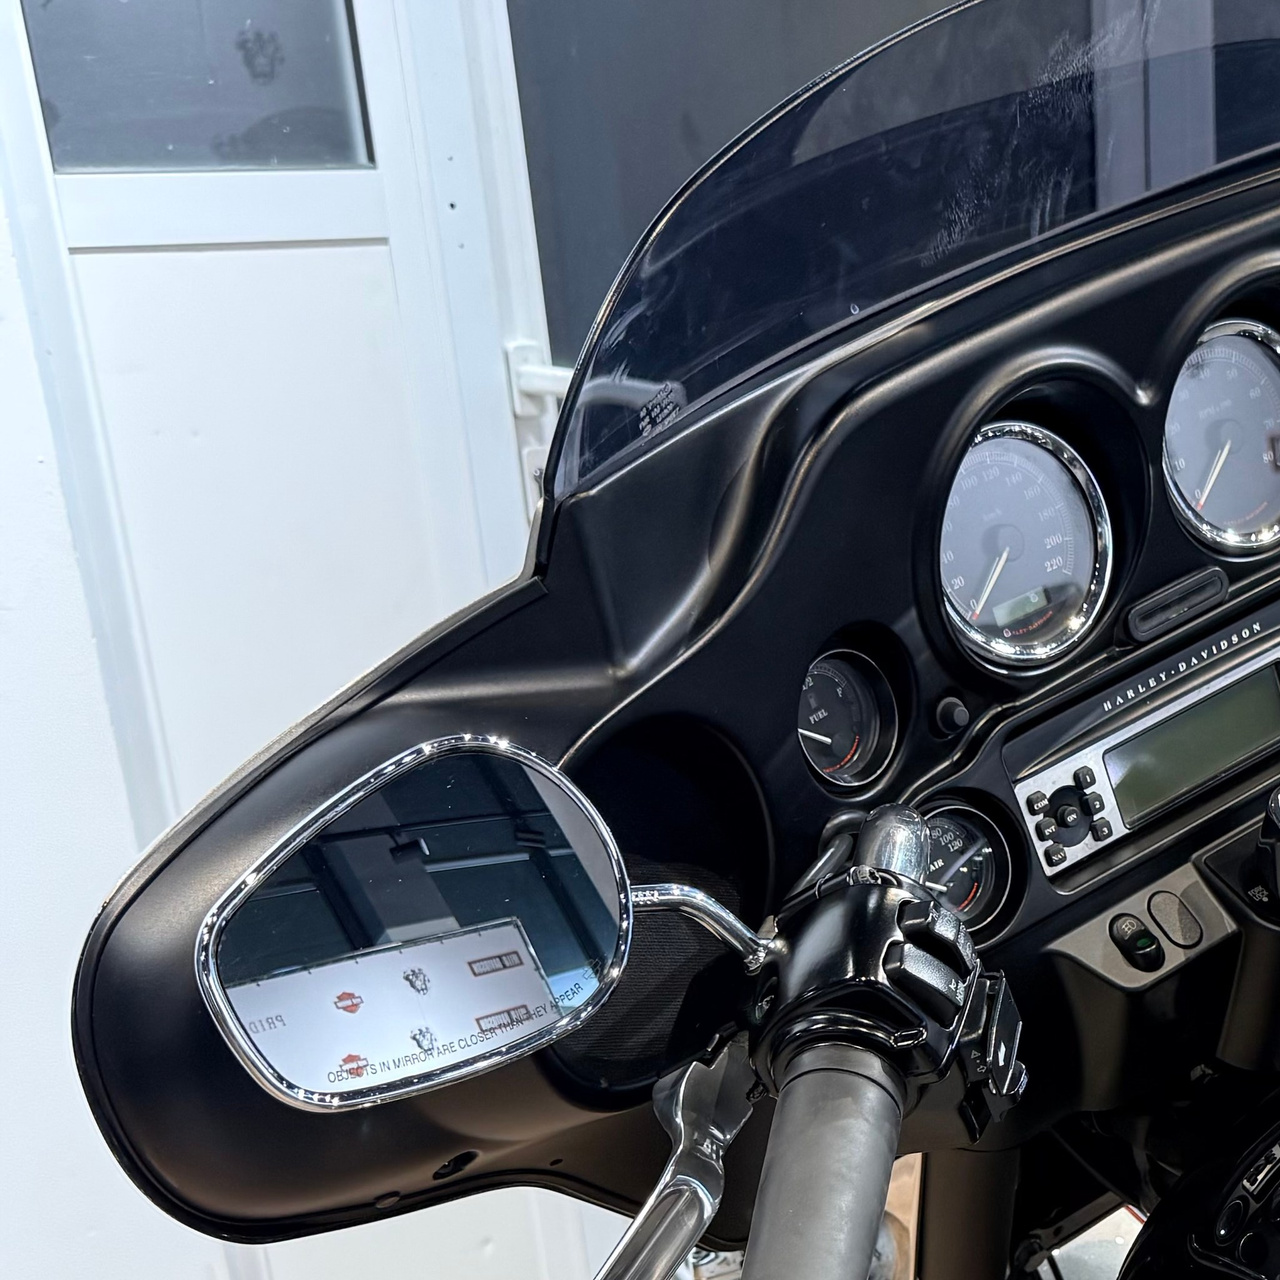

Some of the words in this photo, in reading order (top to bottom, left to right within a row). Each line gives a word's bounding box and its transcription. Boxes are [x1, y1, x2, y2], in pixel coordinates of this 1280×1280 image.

[1174, 458, 1186, 472] 10
[1262, 451, 1275, 464] 80
[960, 475, 979, 491] 100
[982, 465, 1000, 482] 120
[1005, 471, 1023, 487] 140
[1024, 484, 1041, 501] 160
[1038, 506, 1056, 523] 180
[1044, 532, 1063, 549] 200
[1044, 556, 1063, 573] 220
[951, 574, 965, 591] 20
[808, 708, 829, 725] FUEL
[1033, 798, 1049, 811] COM
[1093, 800, 1101, 809] 2
[1066, 814, 1078, 823] ON
[930, 827, 942, 840] 80
[1044, 824, 1057, 836] INT
[1102, 826, 1109, 836] 3
[939, 831, 955, 846] 100
[947, 838, 964, 853] 120
[1051, 851, 1066, 863] NAV
[929, 858, 945, 873] AIR
[327, 1063, 378, 1083] OBJECTS
[379, 1060, 391, 1073] IN
[392, 1050, 435, 1070] MIRROR
[436, 1041, 459, 1058] ARE
[457, 1027, 497, 1050] CLOSER
[550, 982, 584, 1011] APPEAR
